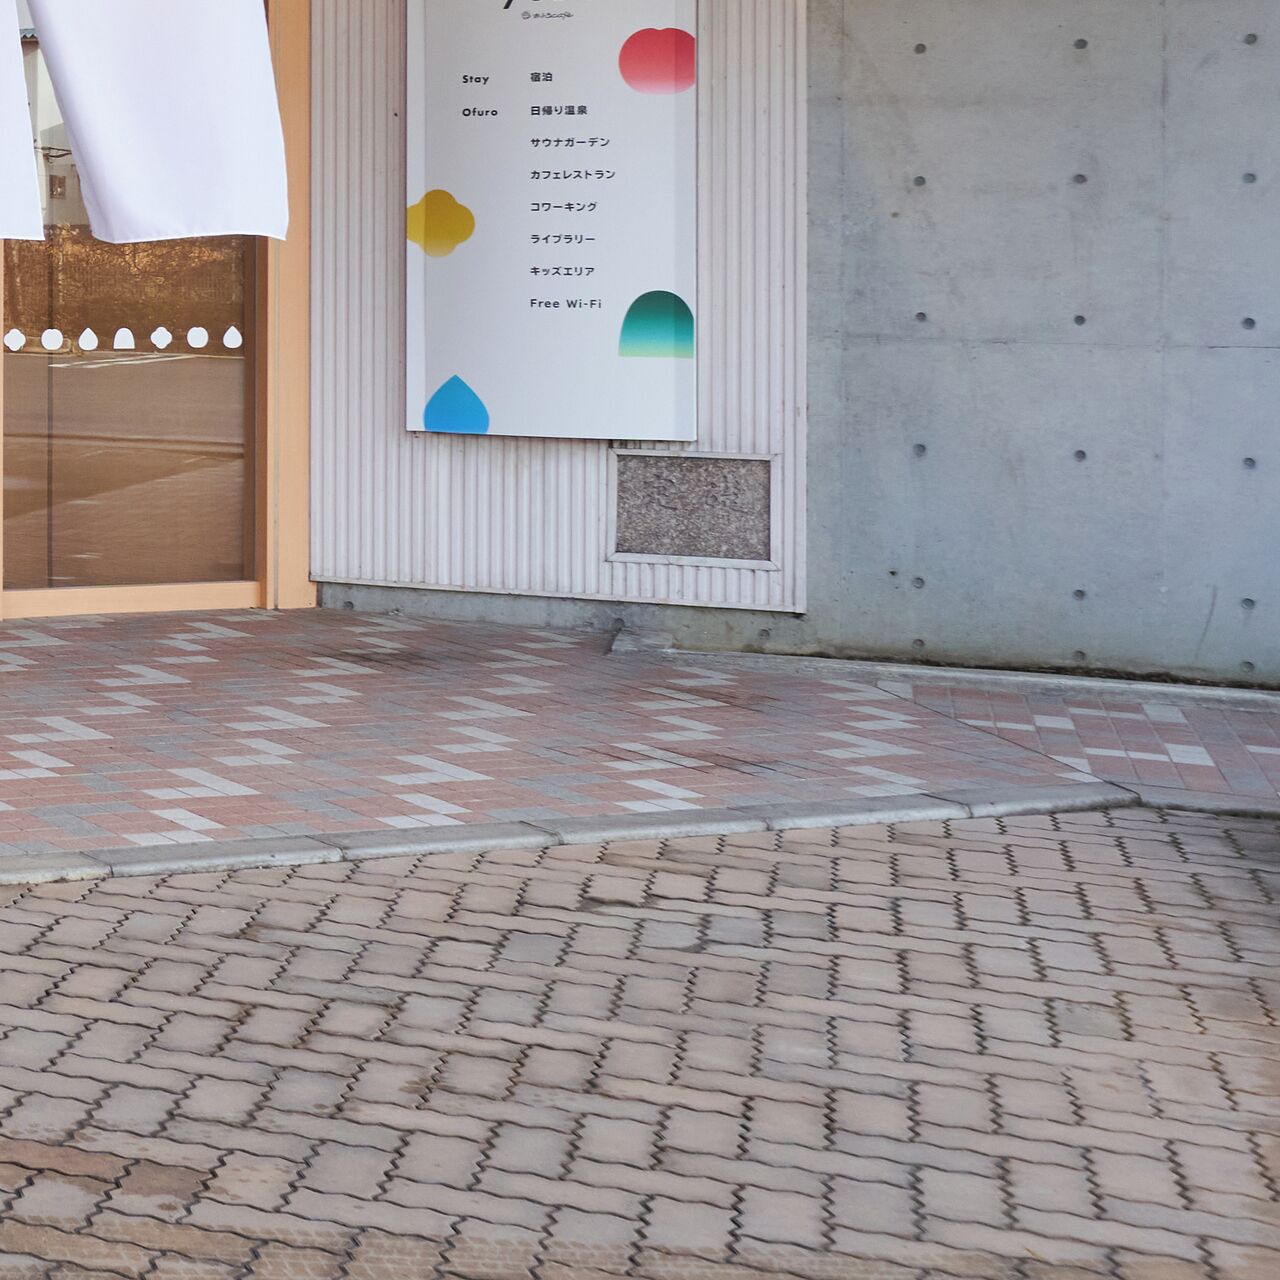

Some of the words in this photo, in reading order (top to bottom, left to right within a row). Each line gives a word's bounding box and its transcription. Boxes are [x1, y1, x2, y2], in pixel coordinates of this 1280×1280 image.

[462, 74, 490, 86] Stay
[530, 71, 553, 83] 宿泊
[462, 107, 499, 117] Ofuro
[530, 105, 588, 116] 日帰り温泉
[530, 137, 610, 148] サウナガーデン
[530, 170, 616, 180] カフェレストラン
[530, 202, 598, 212] コワーキング
[530, 234, 596, 244] ライブラリー
[530, 266, 596, 277] キッズエリア
[530, 298, 560, 309] Free
[566, 298, 602, 309] Wi-Fi
